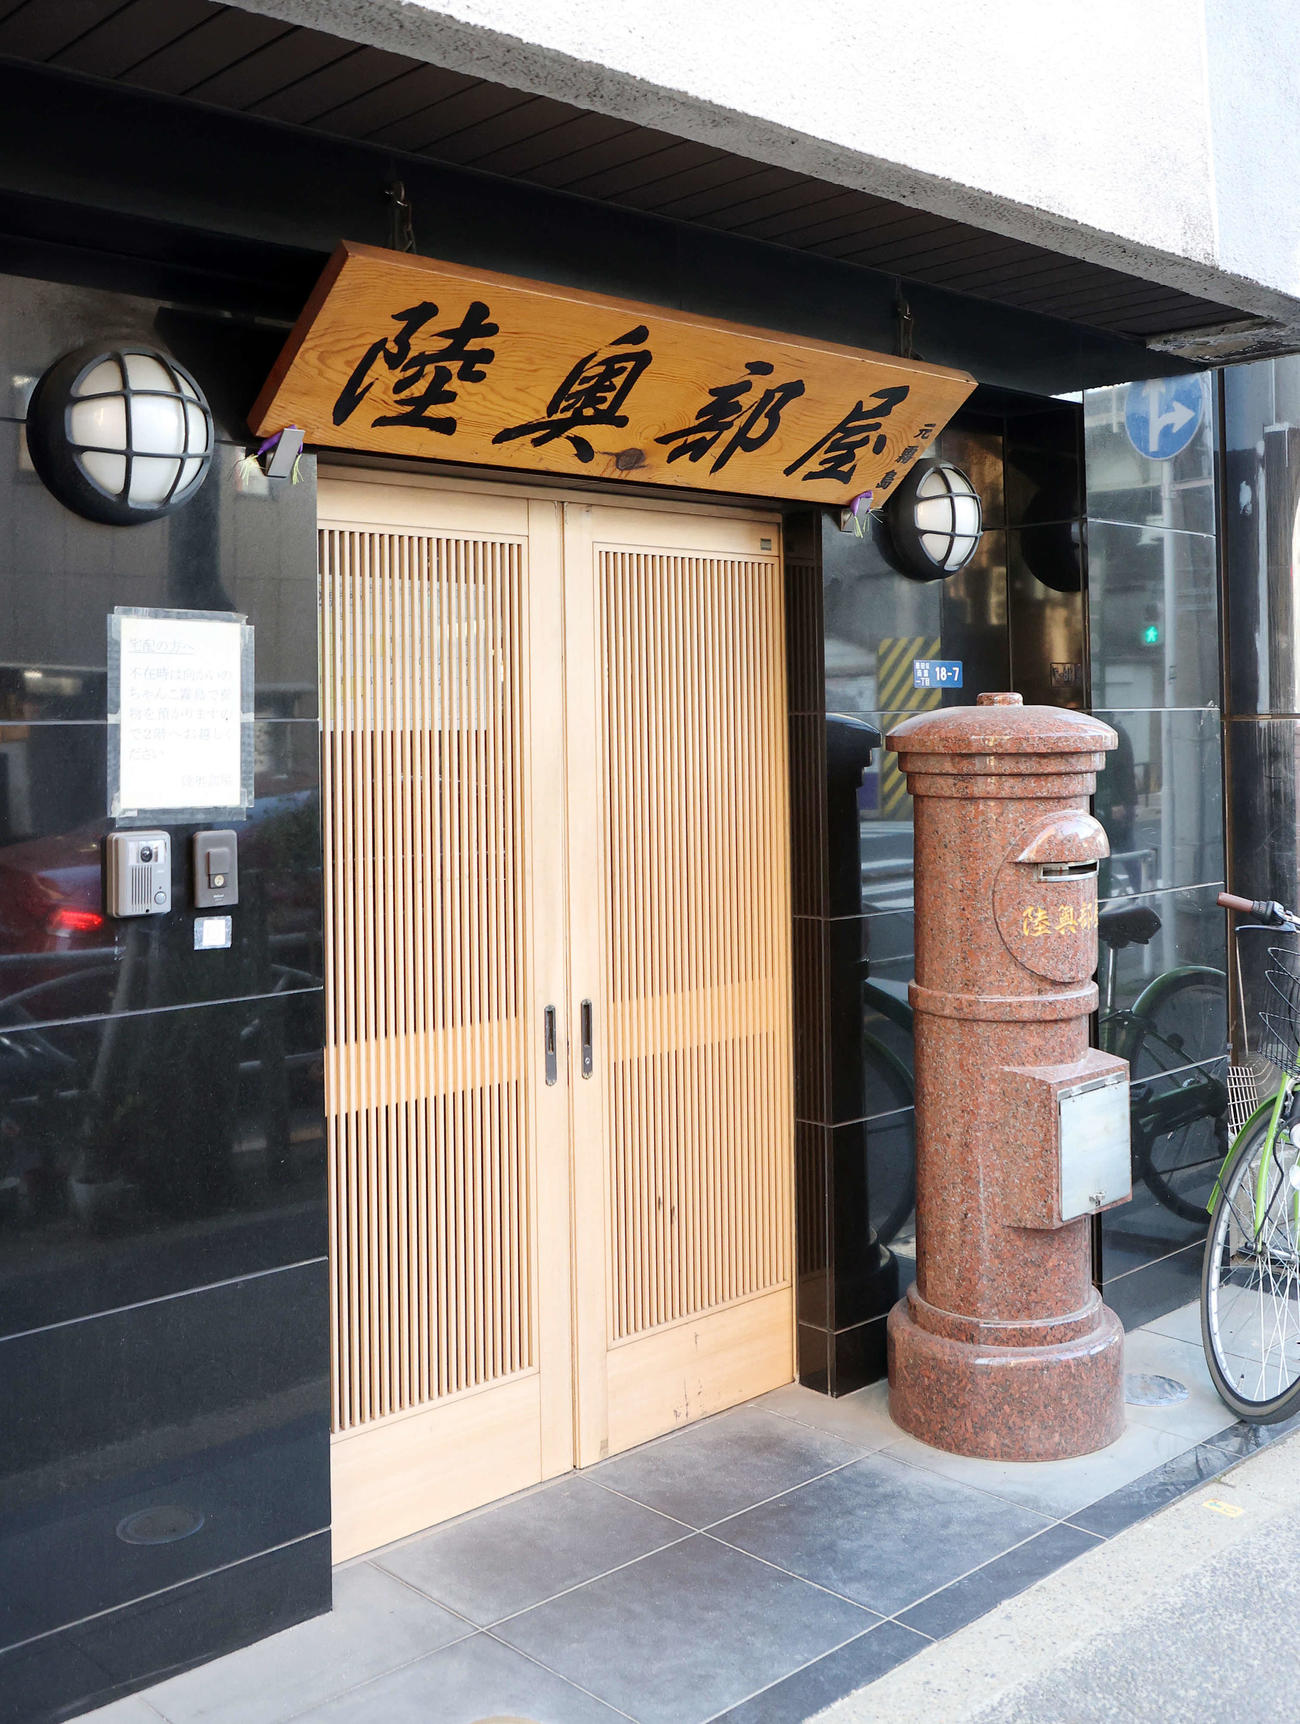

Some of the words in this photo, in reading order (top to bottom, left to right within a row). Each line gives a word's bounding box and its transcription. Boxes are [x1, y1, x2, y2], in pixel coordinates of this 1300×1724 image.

[332, 301, 910, 484] 陸奥部屋
[935, 666, 960, 681] 18-7
